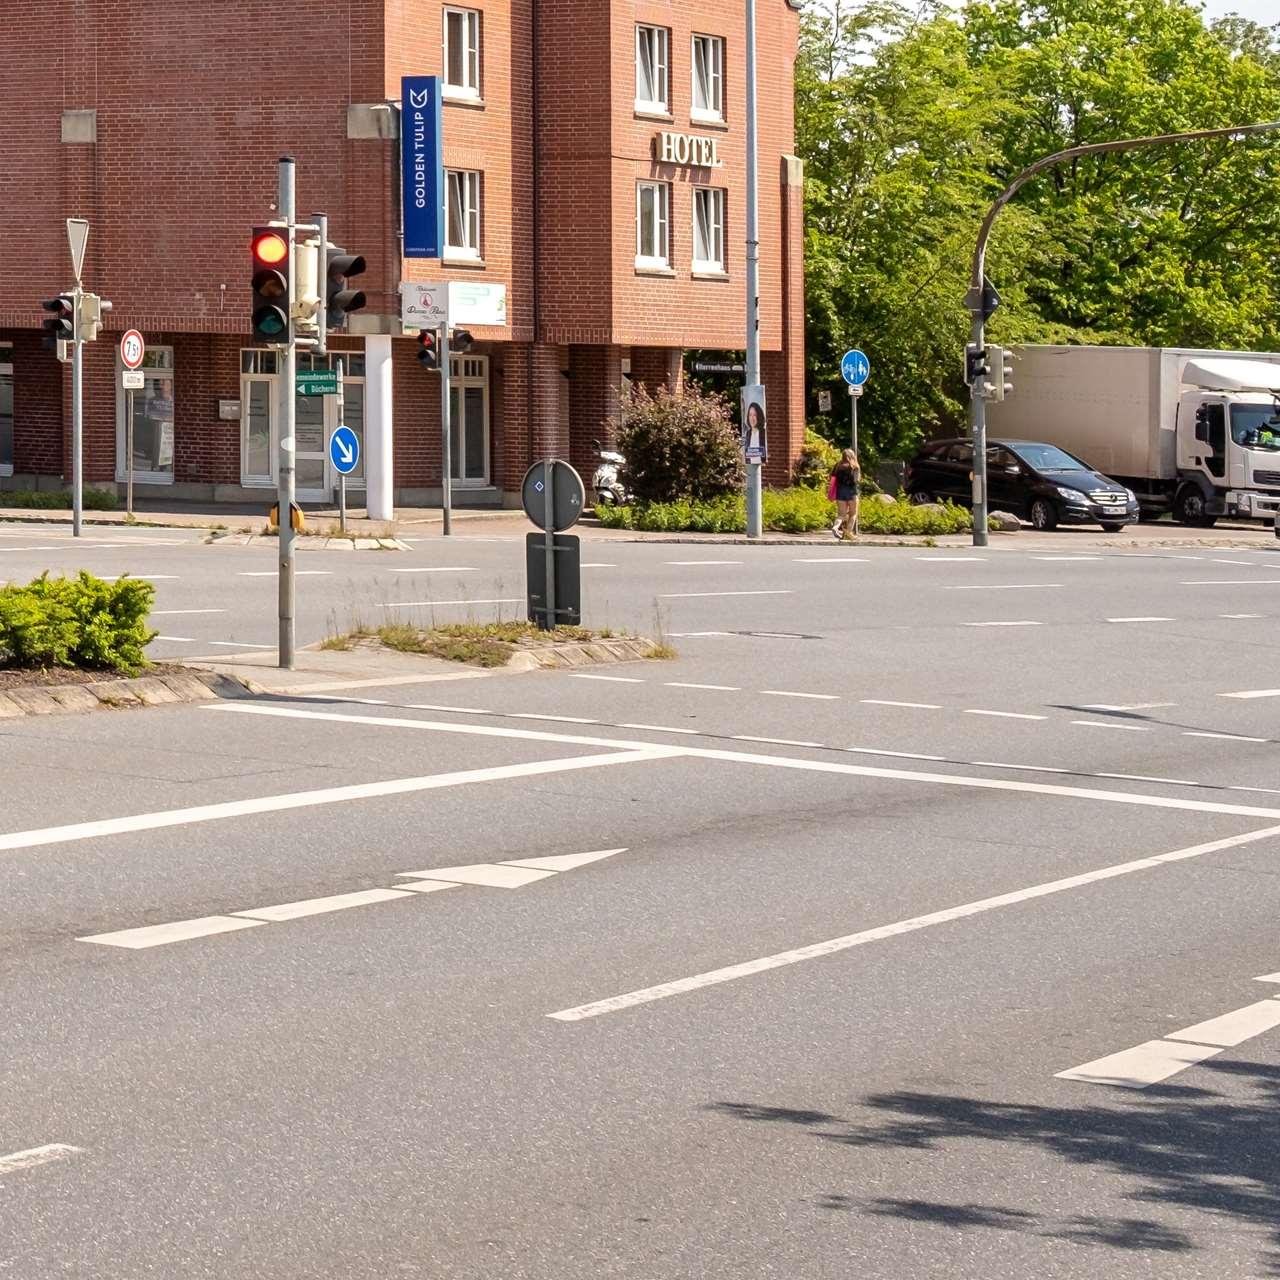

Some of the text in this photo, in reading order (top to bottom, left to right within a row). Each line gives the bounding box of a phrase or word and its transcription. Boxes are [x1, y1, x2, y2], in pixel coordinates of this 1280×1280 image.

[414, 112, 425, 208] GOLDEN TULIP
[660, 131, 722, 167] HOTEL
[297, 373, 336, 381] emeindewerke
